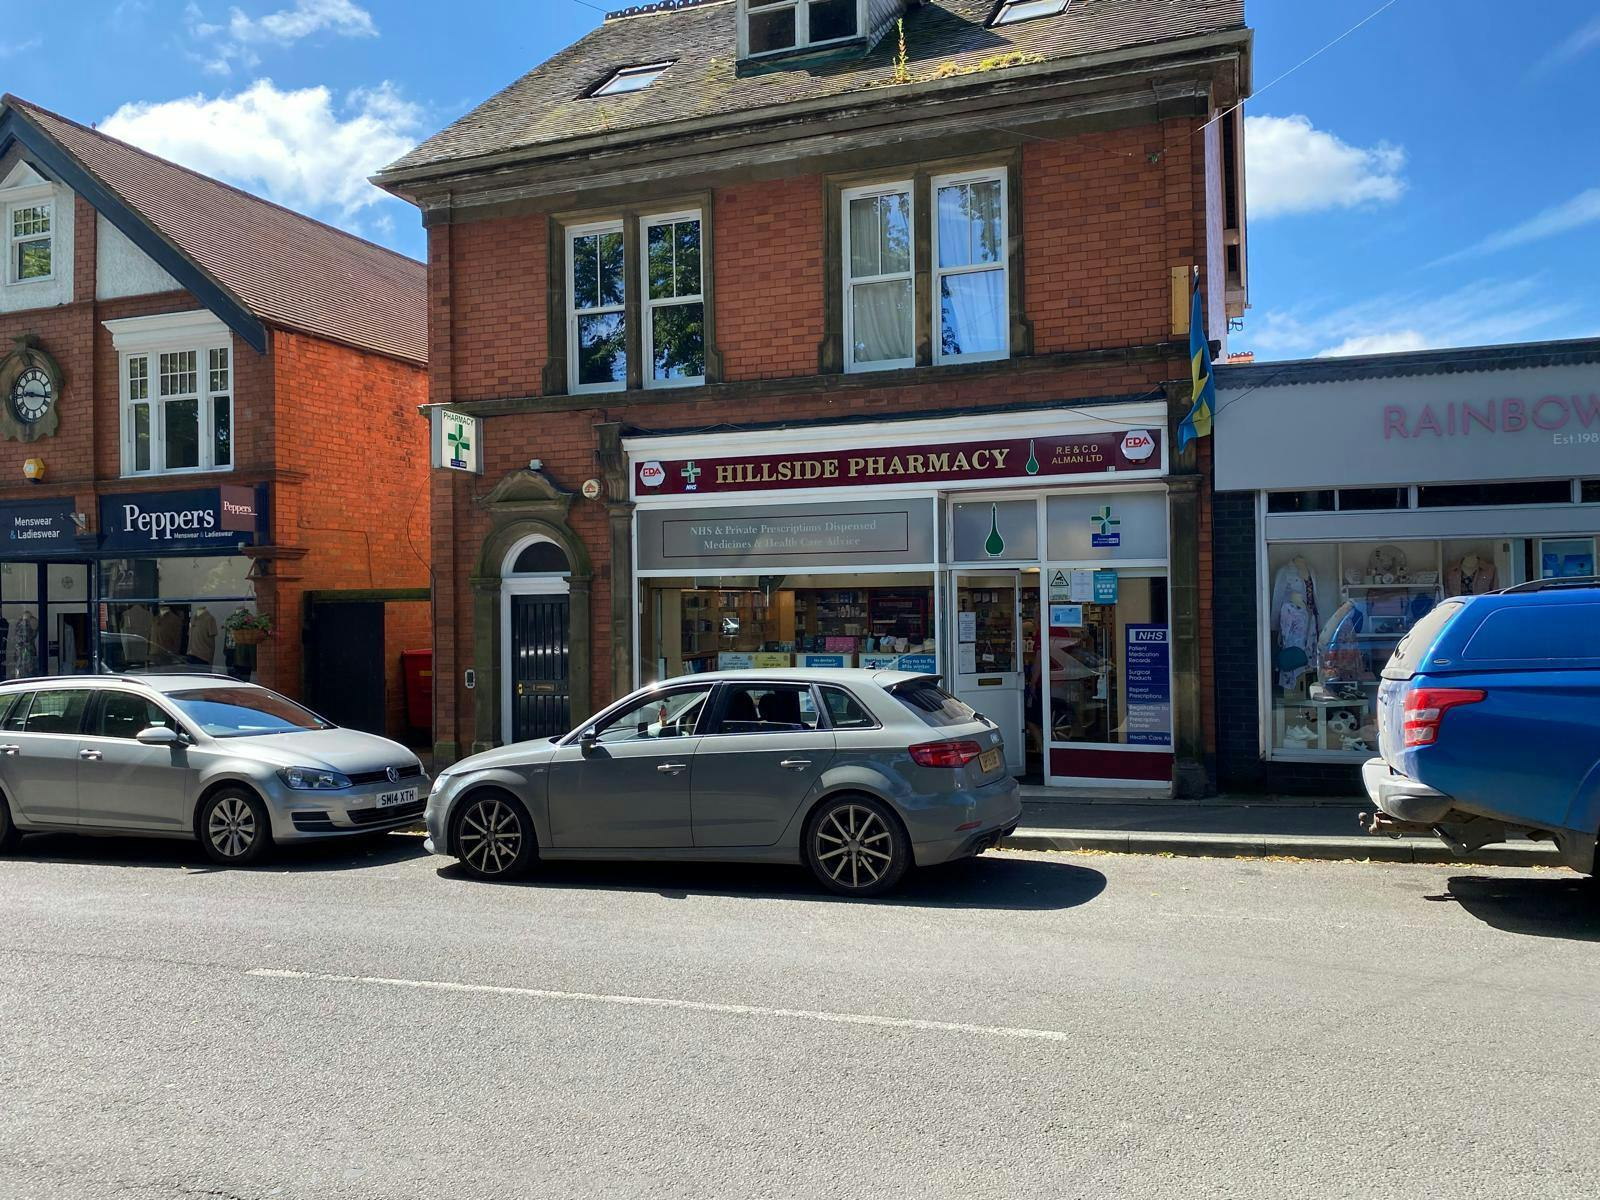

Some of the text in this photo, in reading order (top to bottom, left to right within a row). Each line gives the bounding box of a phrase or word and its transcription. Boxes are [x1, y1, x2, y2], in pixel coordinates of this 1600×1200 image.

[443, 411, 474, 427] PHARMACY
[1073, 445, 1080, 454] &
[1051, 454, 1103, 465] ALMAN LTD
[715, 448, 1010, 484] HILLSIDE PHARMACY
[223, 500, 252, 515] Peppers
[14, 516, 53, 527] Menswear
[122, 504, 215, 540] Peppers
[689, 519, 876, 536] NHS & Private Prescriptions Dispensed
[9, 529, 61, 540] & Ladieswear
[204, 530, 233, 538] Ladieswear
[704, 539, 752, 550] Medicines
[1138, 631, 1164, 640] NHS
[400, 790, 414, 802] XTH
